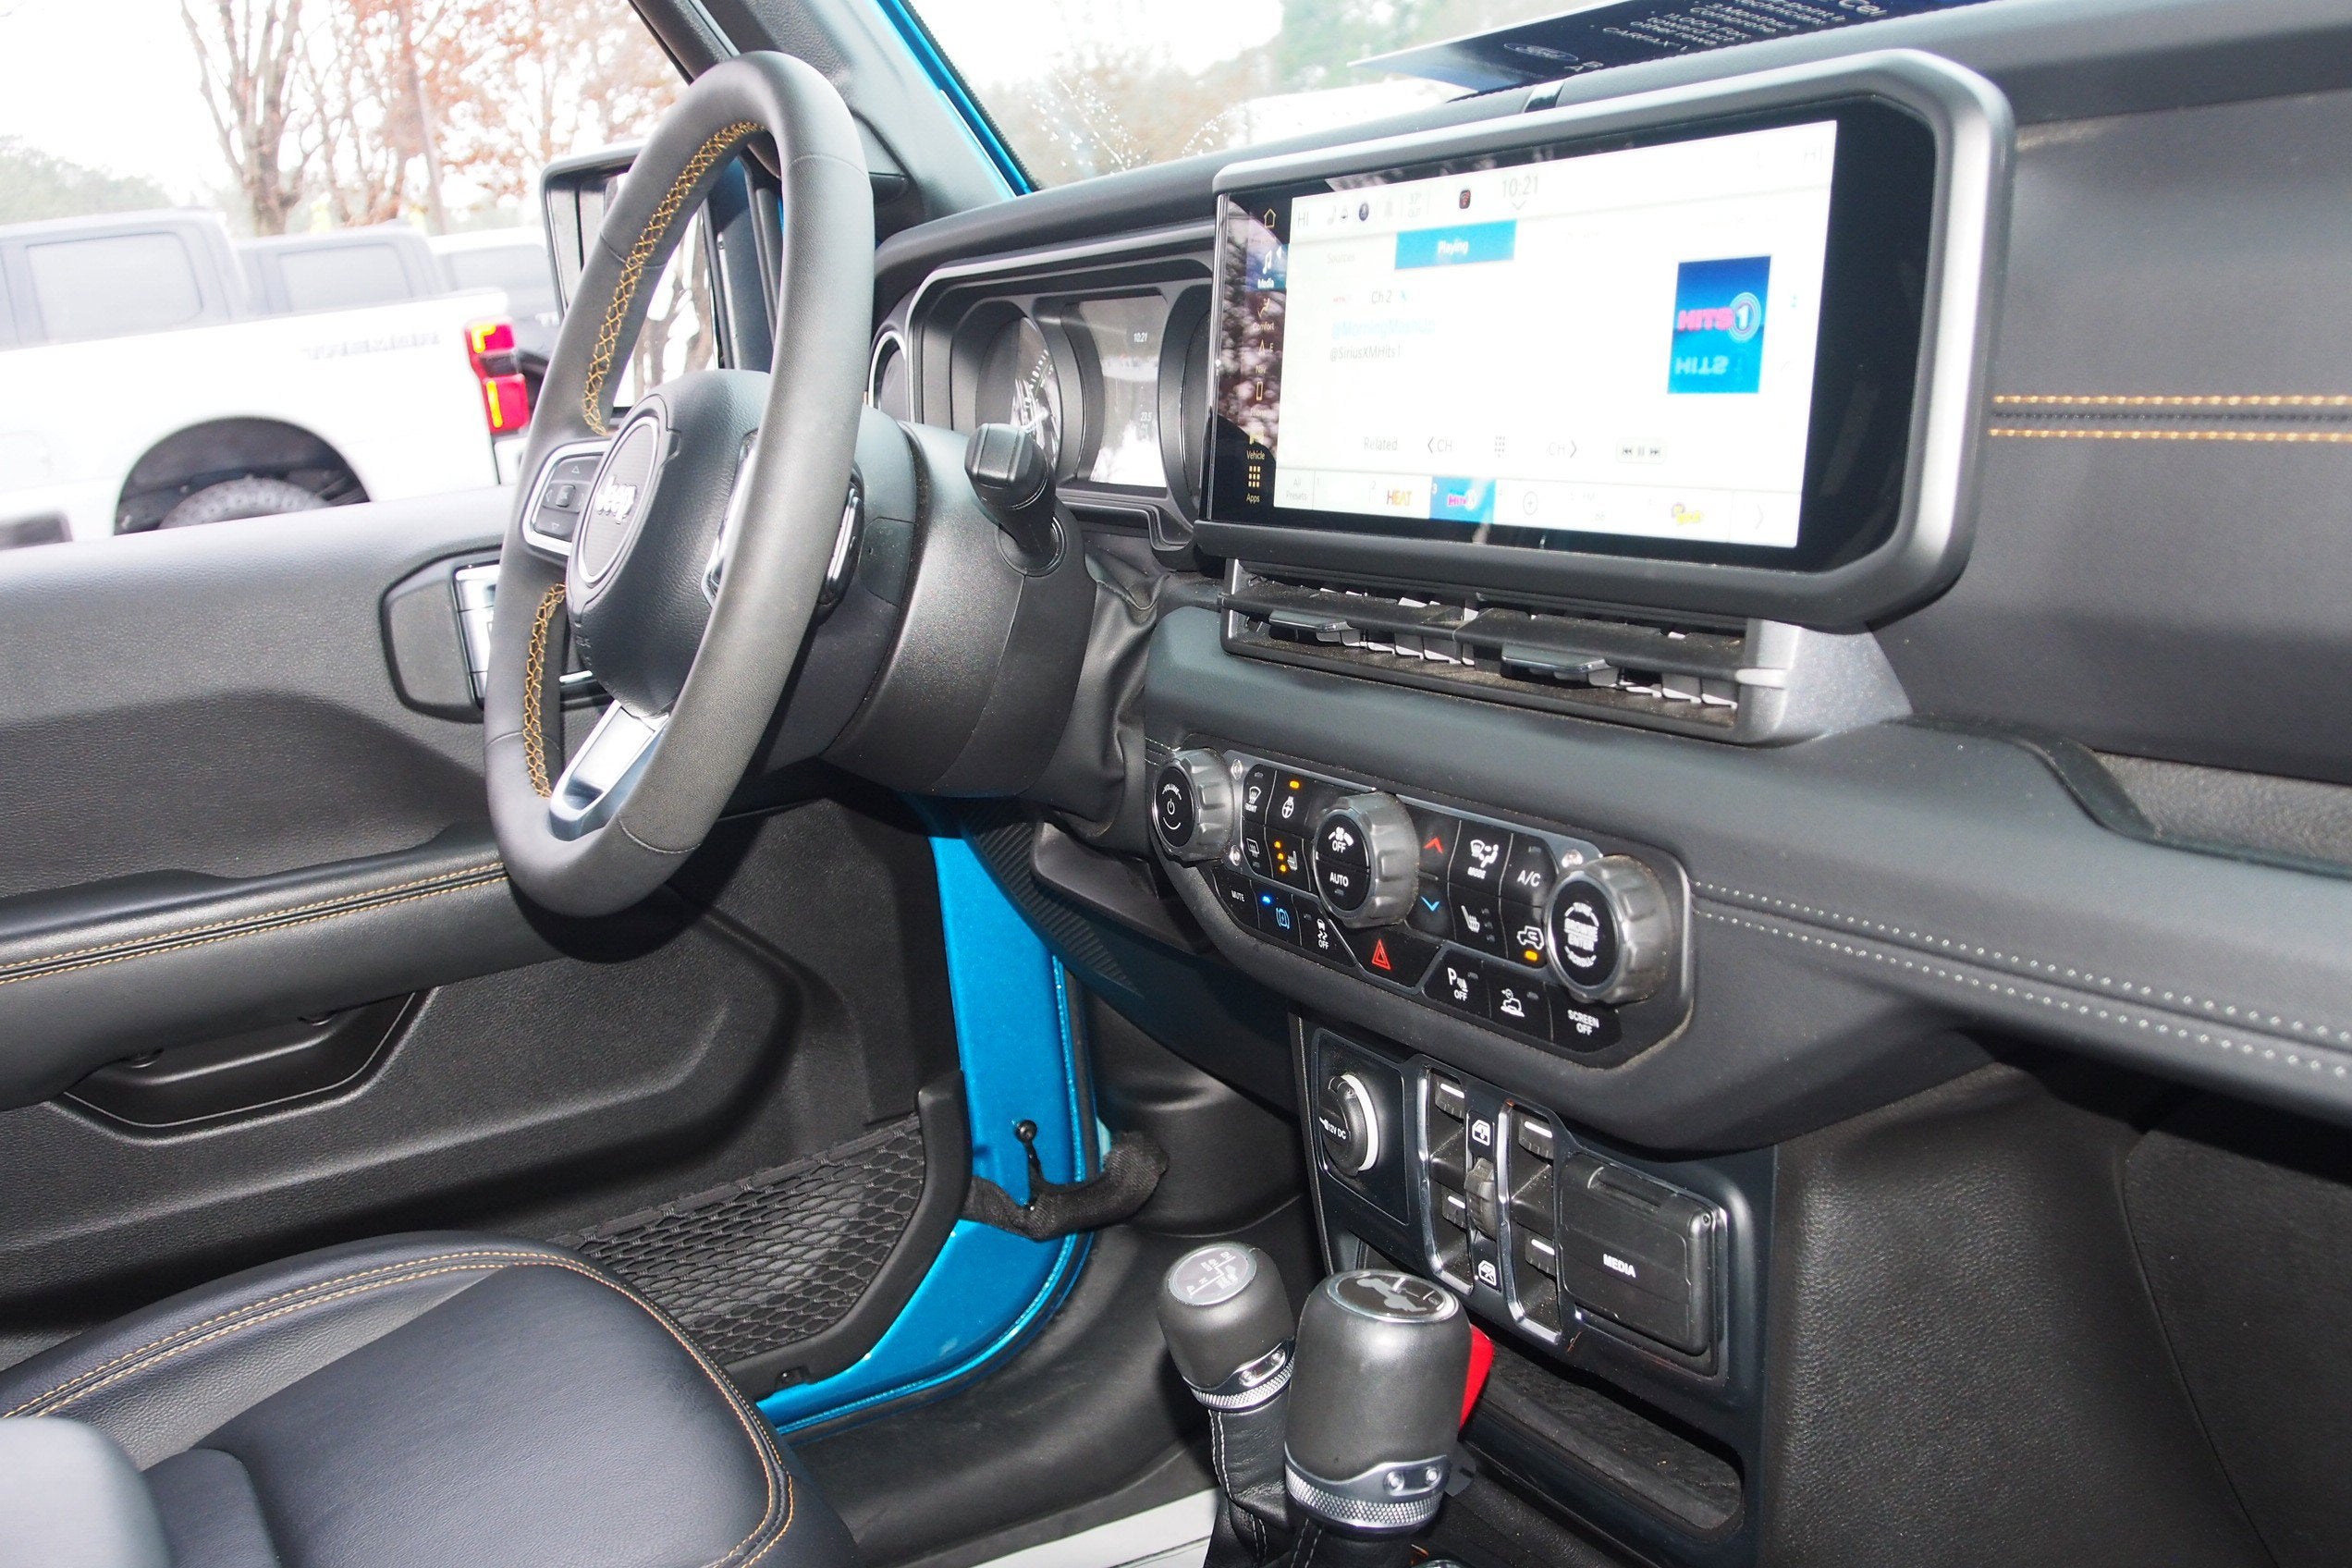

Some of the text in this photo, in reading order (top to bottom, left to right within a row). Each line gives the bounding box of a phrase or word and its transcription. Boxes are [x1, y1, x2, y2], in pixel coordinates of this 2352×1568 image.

[1501, 175, 1538, 199] 10:21
[1438, 239, 1469, 256] Playing
[596, 474, 637, 524] Jeep
[1246, 494, 1260, 507] Apps
[1332, 839, 1346, 852] OFF
[1467, 866, 1487, 879] MODE
[1517, 870, 1541, 888] A/C
[1329, 872, 1349, 888] AUTO
[1231, 889, 1245, 902] MUTE
[1318, 939, 1329, 949] OFF
[1453, 988, 1468, 1001] OFF
[1567, 1009, 1600, 1028] SCREEN
[1575, 1023, 1593, 1036] OFF
[1337, 1127, 1347, 1140] DC
[1603, 1253, 1636, 1278] MEDIA
